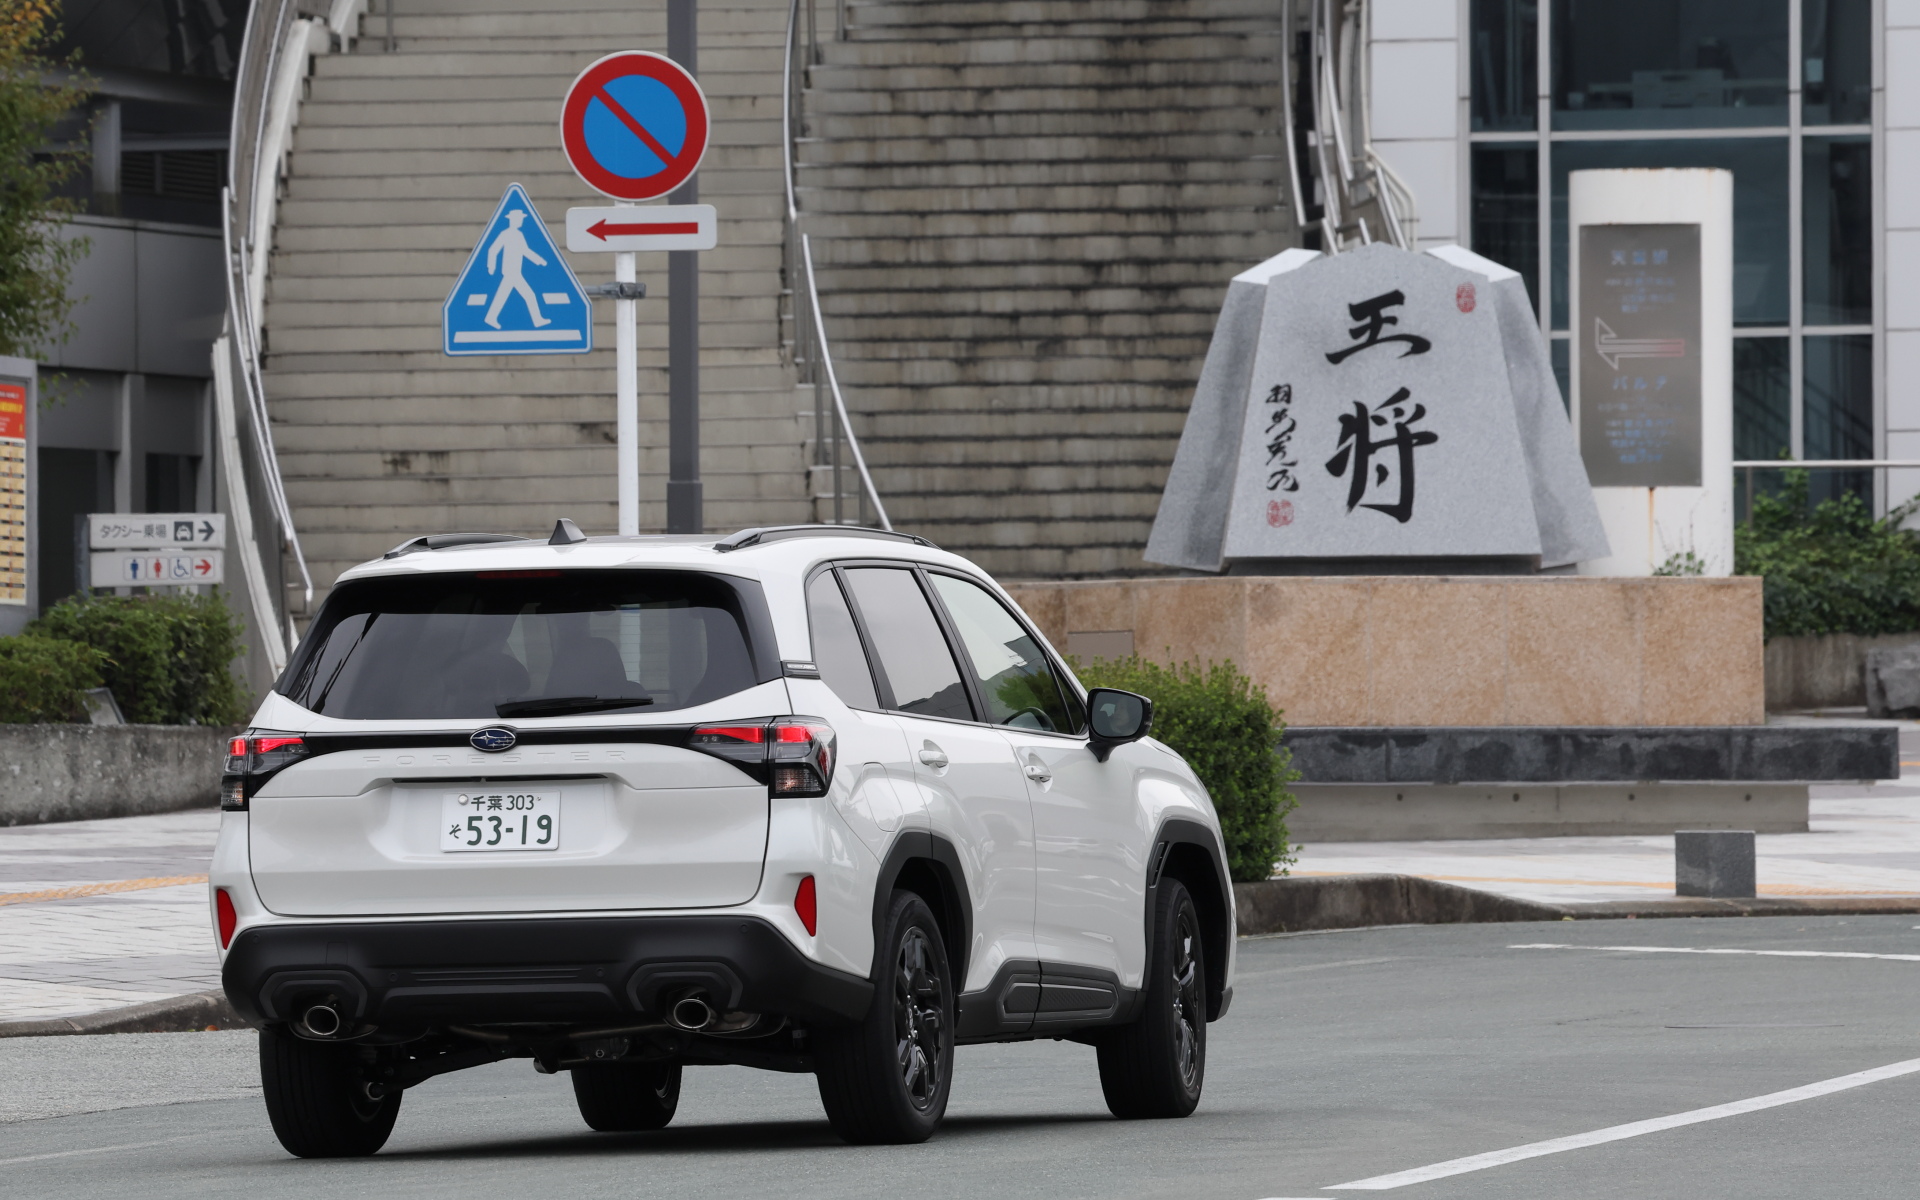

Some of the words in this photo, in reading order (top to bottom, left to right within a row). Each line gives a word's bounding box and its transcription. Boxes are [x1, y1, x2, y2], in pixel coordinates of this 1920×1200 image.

[1325, 289, 1438, 523] 王将
[100, 524, 167, 539] タクシー乗場
[362, 750, 626, 768] FORESTER
[470, 795, 503, 812] 千葉
[505, 794, 535, 811] 303
[448, 823, 462, 839] そ
[466, 814, 553, 846] 53-19
